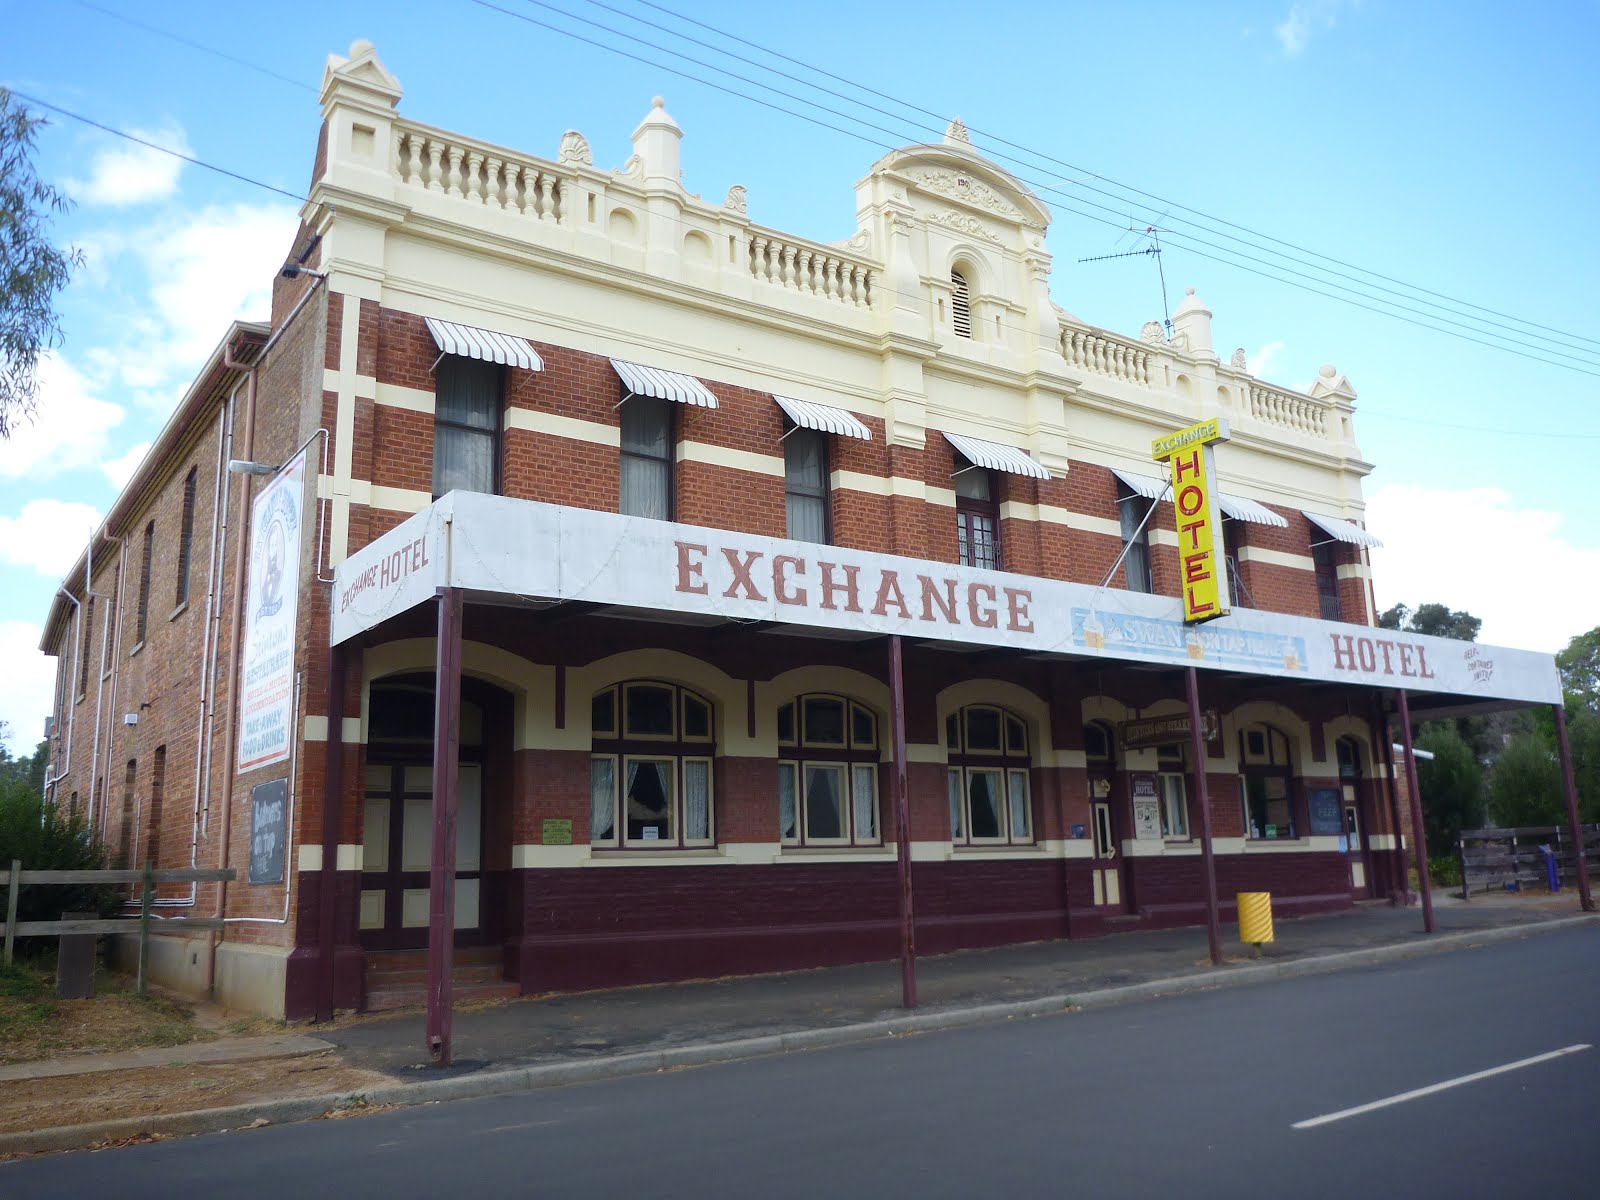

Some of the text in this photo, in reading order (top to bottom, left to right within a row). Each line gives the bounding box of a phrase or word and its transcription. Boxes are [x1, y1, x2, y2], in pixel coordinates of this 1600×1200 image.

[1152, 423, 1215, 455] EXCHANGE
[1174, 450, 1214, 615] HOTEL
[341, 535, 429, 614] EXCHANGE HOTEL
[674, 541, 1035, 634] EXCHANGE
[1122, 620, 1183, 648] SWAN
[1329, 633, 1435, 680] HOTEL
[261, 726, 285, 751] DRINKS
